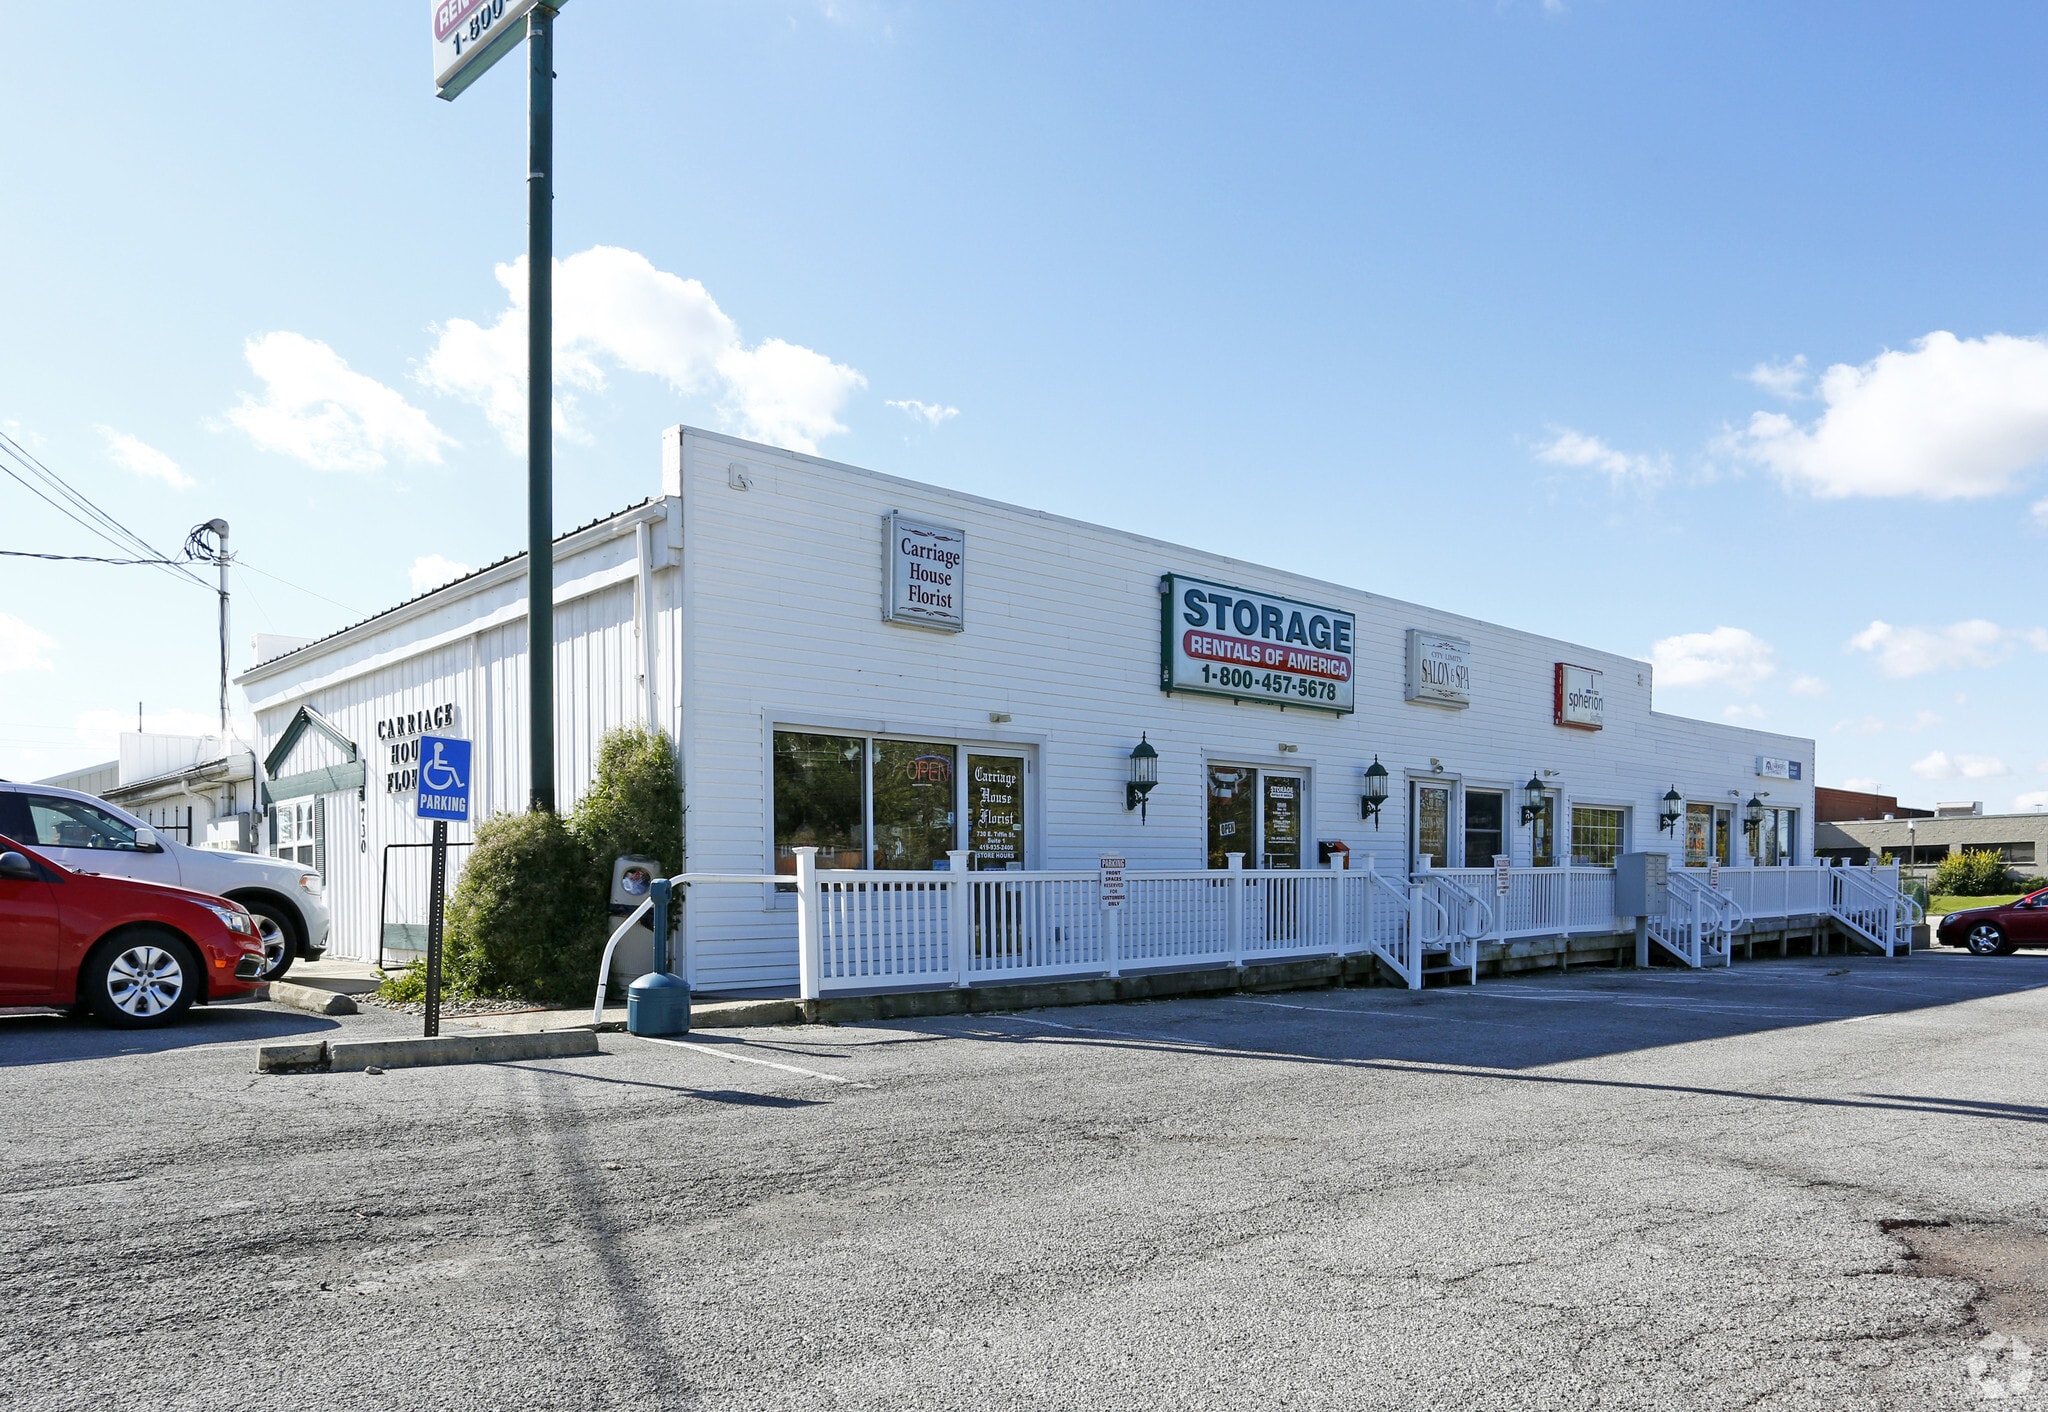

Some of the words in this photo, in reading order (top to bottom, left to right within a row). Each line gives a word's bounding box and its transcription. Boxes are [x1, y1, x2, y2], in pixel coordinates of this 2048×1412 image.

[453, 0, 510, 55] 1-800
[901, 537, 960, 569] Carriage
[909, 562, 952, 586] House
[908, 584, 952, 608] Florist
[1183, 588, 1351, 654] STORAGE
[1191, 635, 1261, 662] RENTALS
[1265, 649, 1284, 666] OF
[1287, 651, 1348, 677] AMERICA
[1431, 651, 1443, 660] CITY
[1445, 654, 1462, 662] LIMITS
[1202, 664, 1336, 701] 1-800-457-5678
[1422, 658, 1450, 686] SALON
[1455, 665, 1470, 689] SPA
[1568, 687, 1603, 712] spherion
[377, 703, 453, 741] CARRIAGE
[391, 739, 419, 765] HOU
[386, 768, 418, 794] FLOR
[906, 760, 949, 782] OPEN
[974, 766, 1017, 788] Carriage
[420, 793, 466, 813] PARKING
[980, 787, 1012, 807] House
[978, 808, 1014, 829] Florist
[1221, 823, 1235, 834] OPEN
[1101, 859, 1125, 868] PARKING
